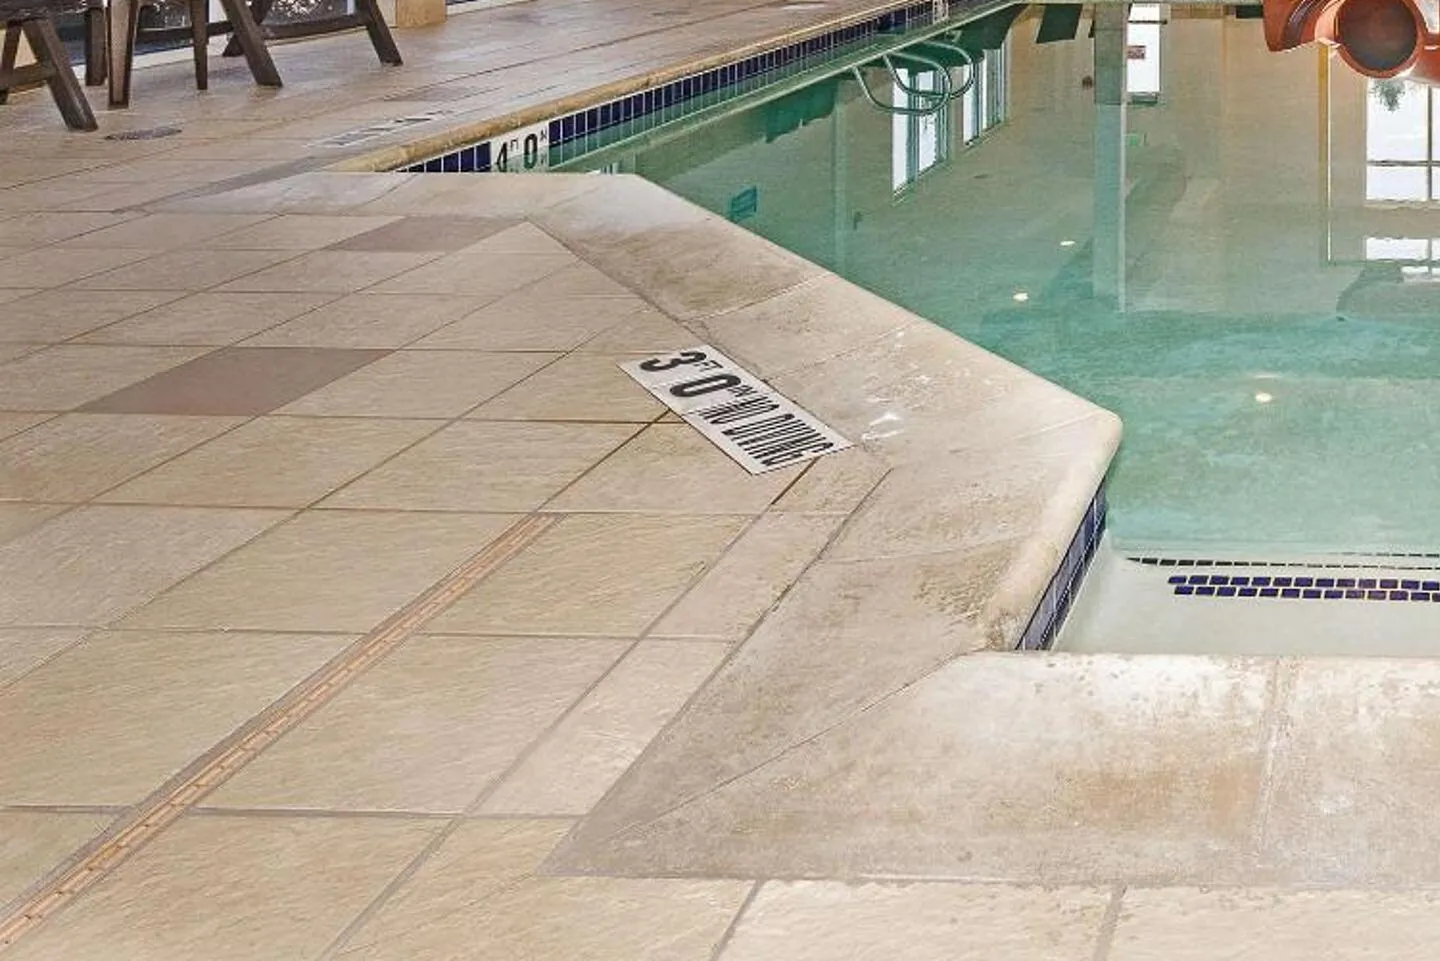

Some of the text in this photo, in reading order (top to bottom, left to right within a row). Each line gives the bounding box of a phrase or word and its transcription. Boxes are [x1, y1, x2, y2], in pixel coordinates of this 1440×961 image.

[640, 351, 707, 372] 3
[669, 373, 741, 398] 0
[699, 395, 834, 466] NO DIVING
